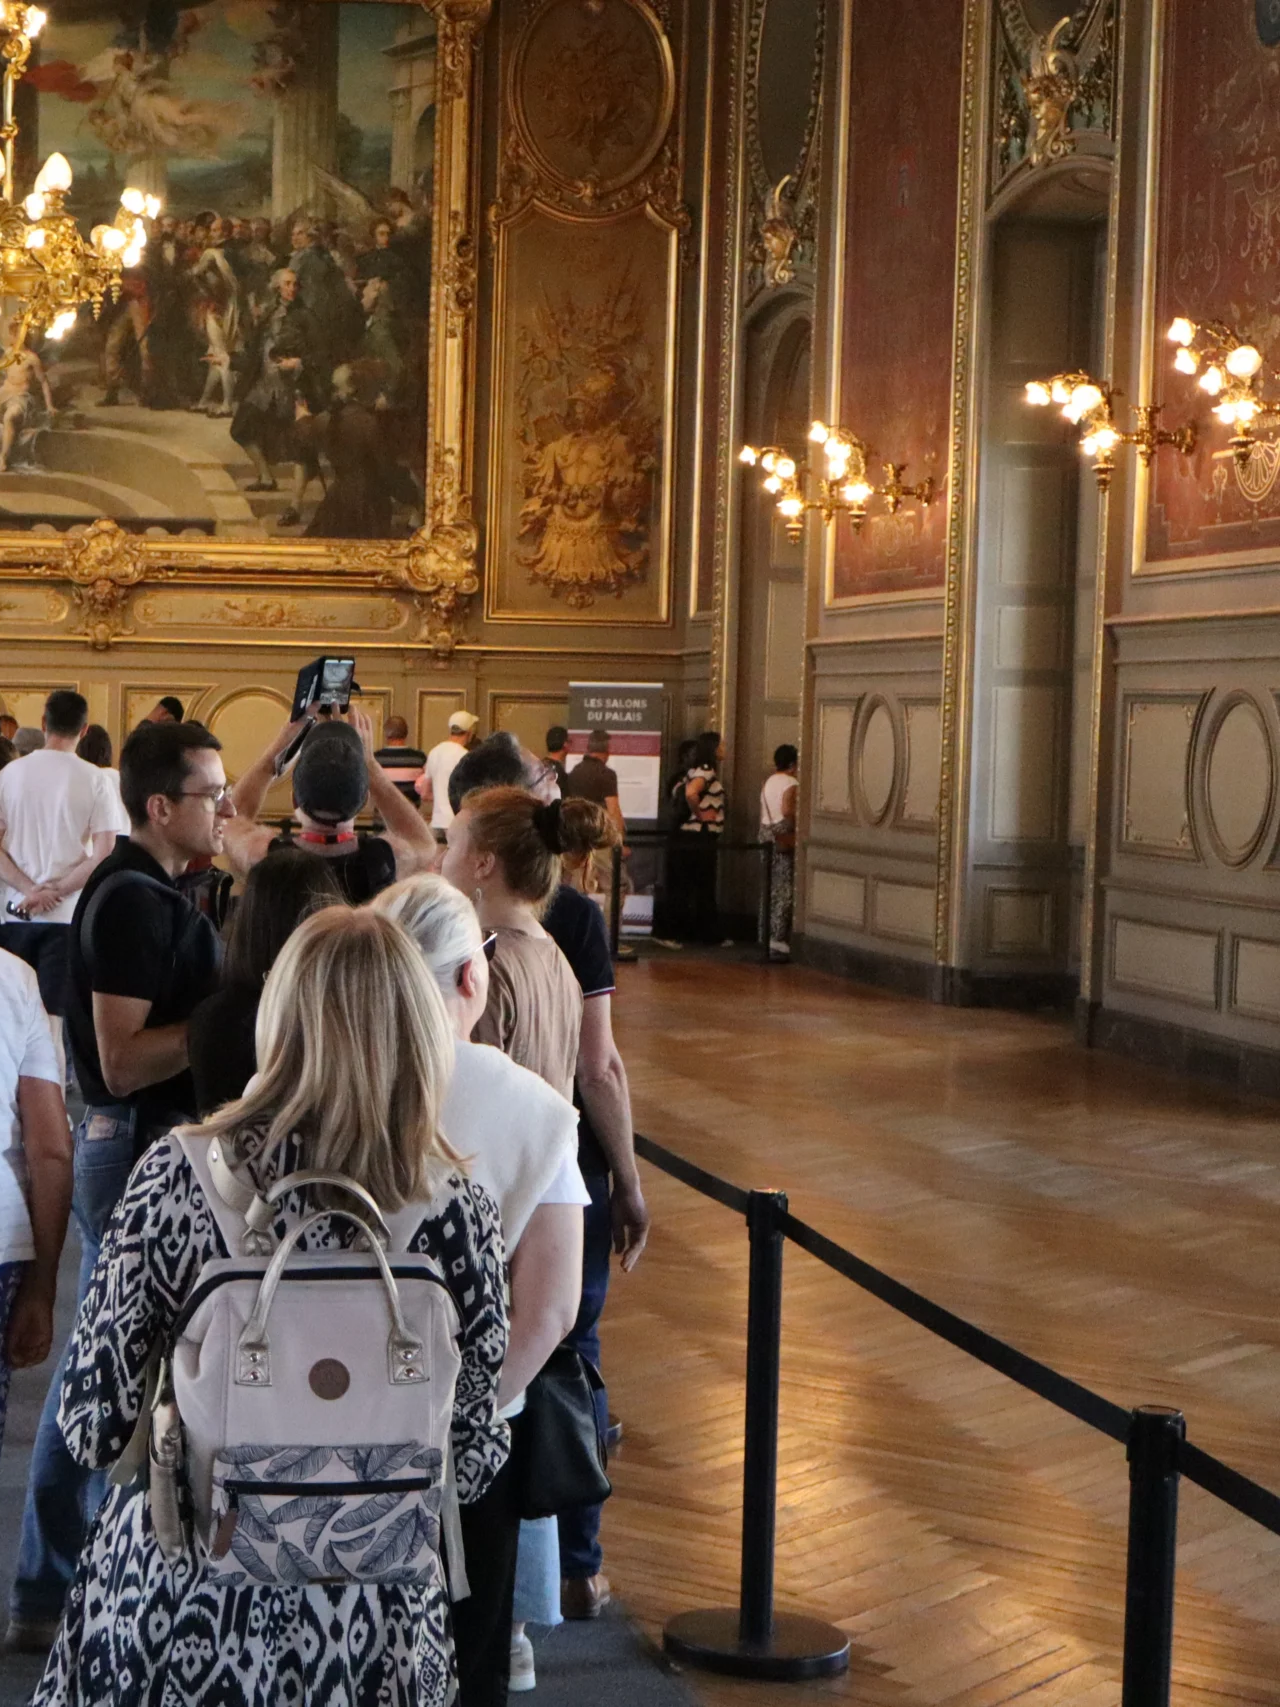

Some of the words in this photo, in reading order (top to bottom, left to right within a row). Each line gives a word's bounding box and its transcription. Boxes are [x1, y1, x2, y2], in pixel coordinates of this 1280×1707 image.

[583, 698, 603, 708] LES
[605, 698, 647, 709] SALONS
[587, 711, 602, 721] DU
[605, 711, 642, 721] PALAIS
